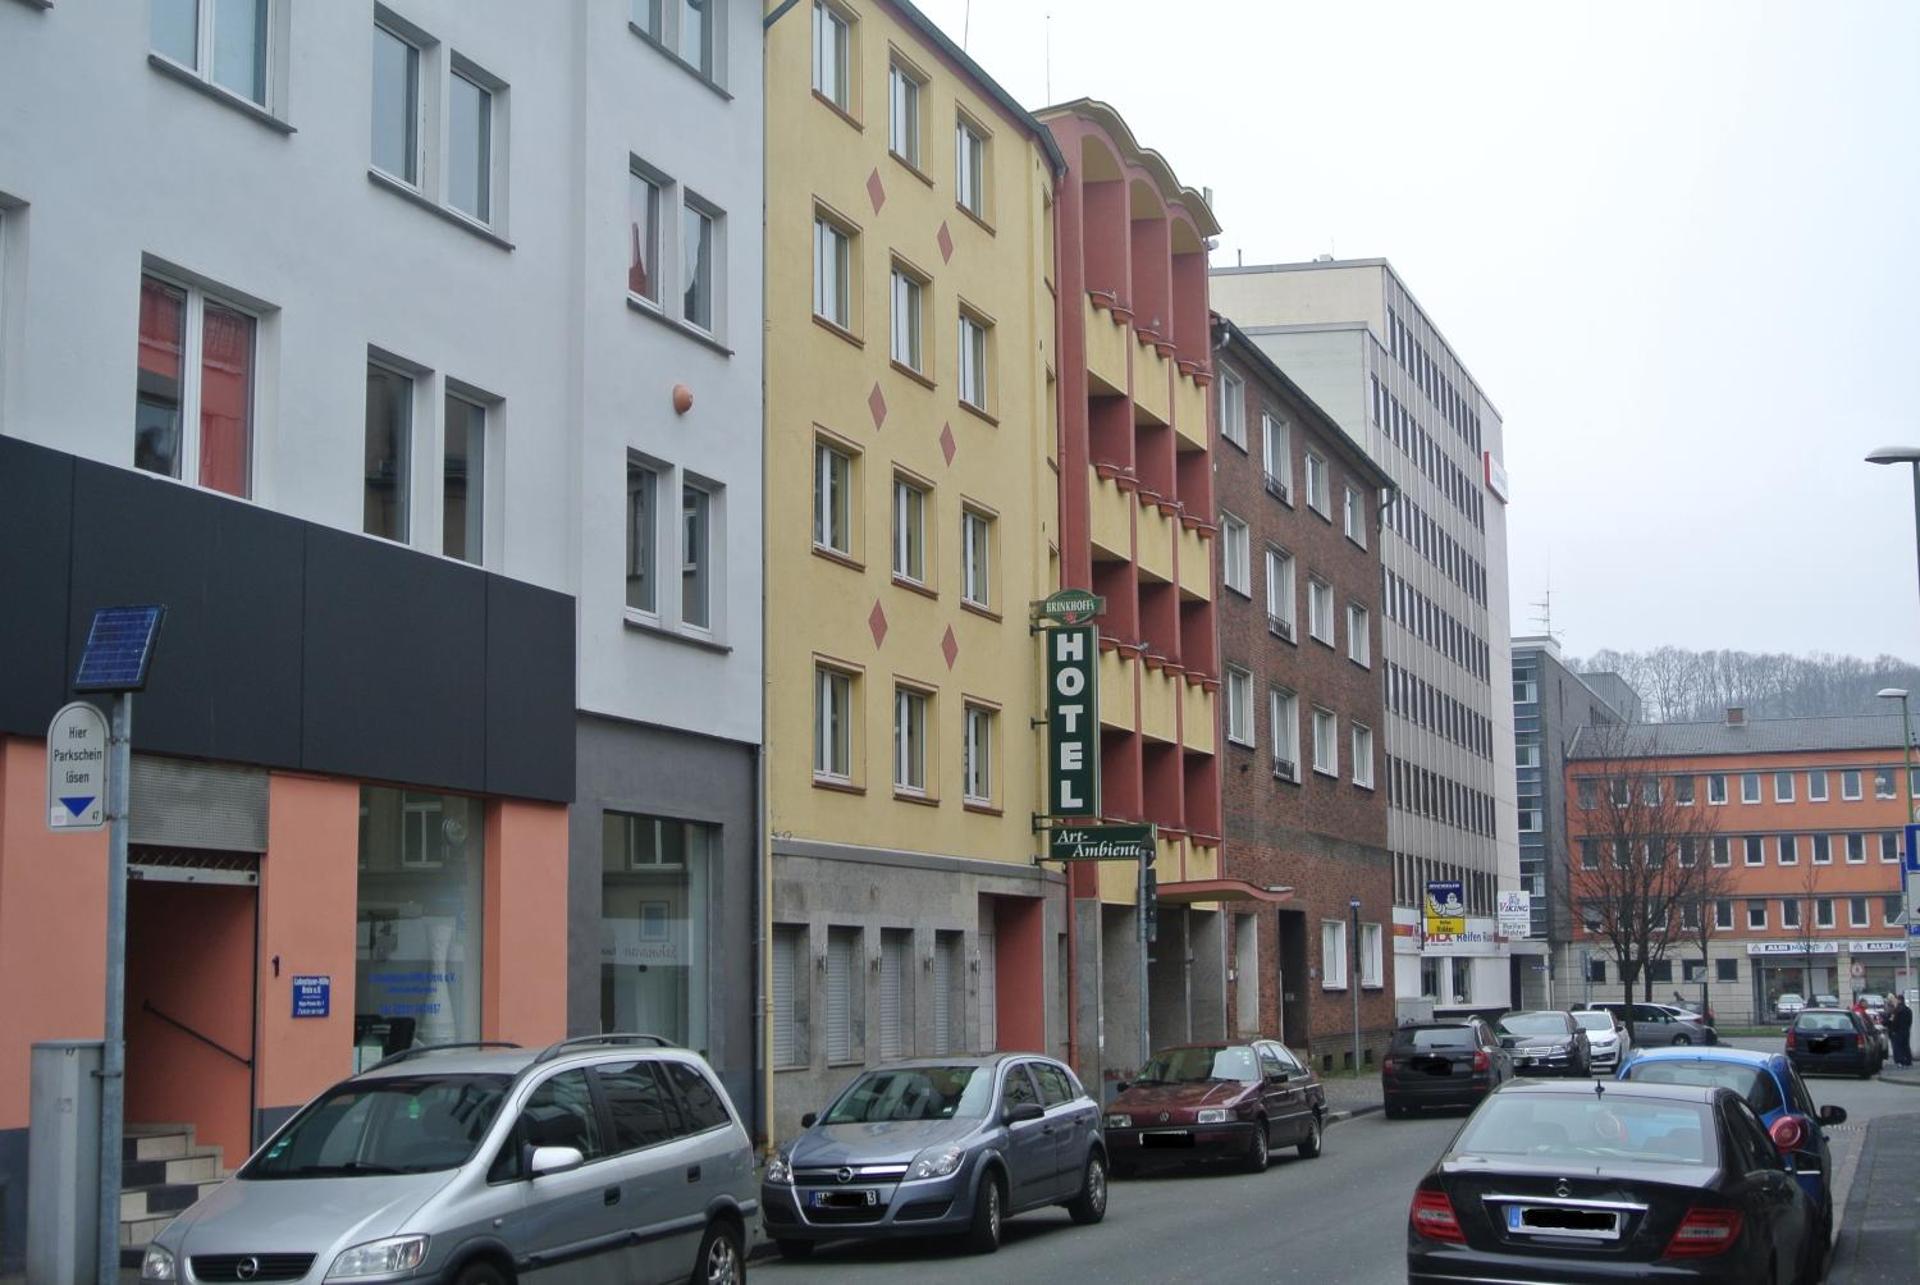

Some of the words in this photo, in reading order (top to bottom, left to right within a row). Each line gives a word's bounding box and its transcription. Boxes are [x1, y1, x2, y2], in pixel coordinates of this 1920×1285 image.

[1056, 632, 1085, 809] HOTEL
[68, 727, 88, 739] Hier
[54, 748, 103, 761] Parkschein
[66, 770, 89, 783] lösen
[1057, 829, 1089, 843] Art-
[1500, 902, 1528, 913] VIKING
